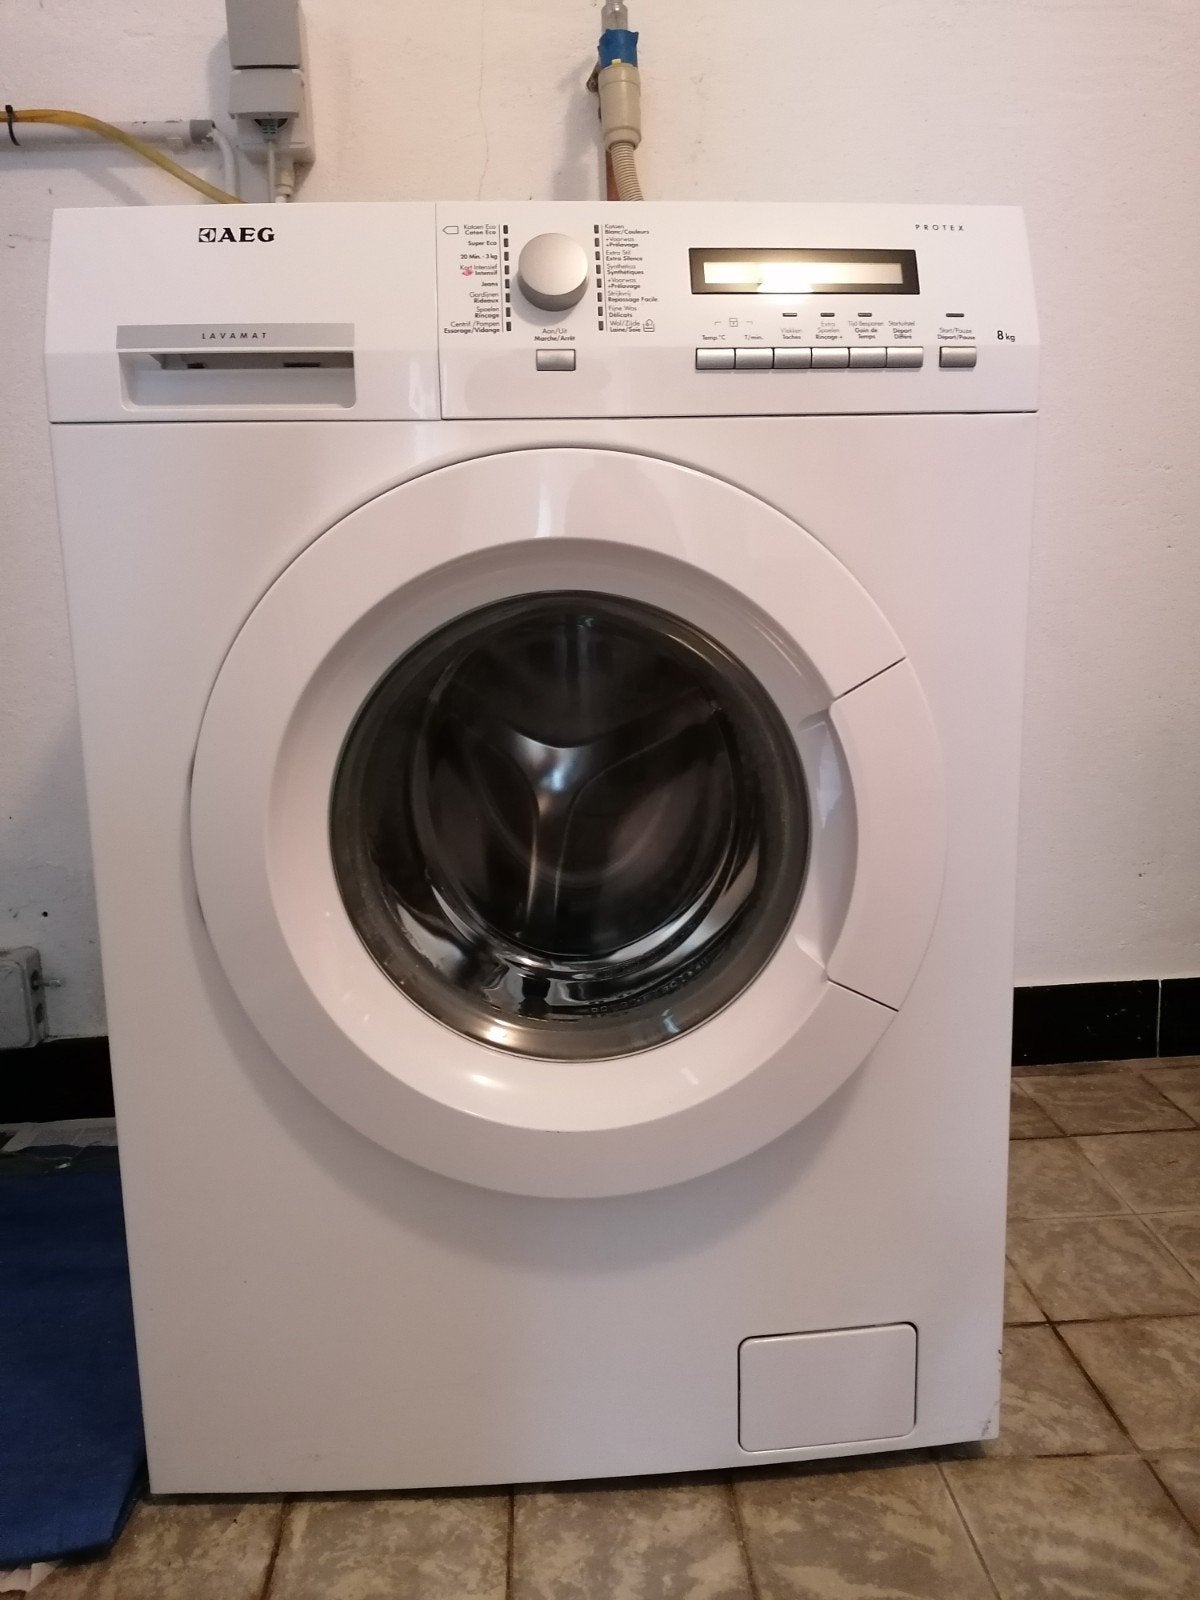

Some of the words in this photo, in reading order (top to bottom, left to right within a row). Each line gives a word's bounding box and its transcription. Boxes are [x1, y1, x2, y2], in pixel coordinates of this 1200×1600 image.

[217, 227, 275, 242] AEG
[202, 332, 267, 340] LAVAMAT
[997, 330, 1004, 340] 8
[1005, 333, 1016, 342] kg
